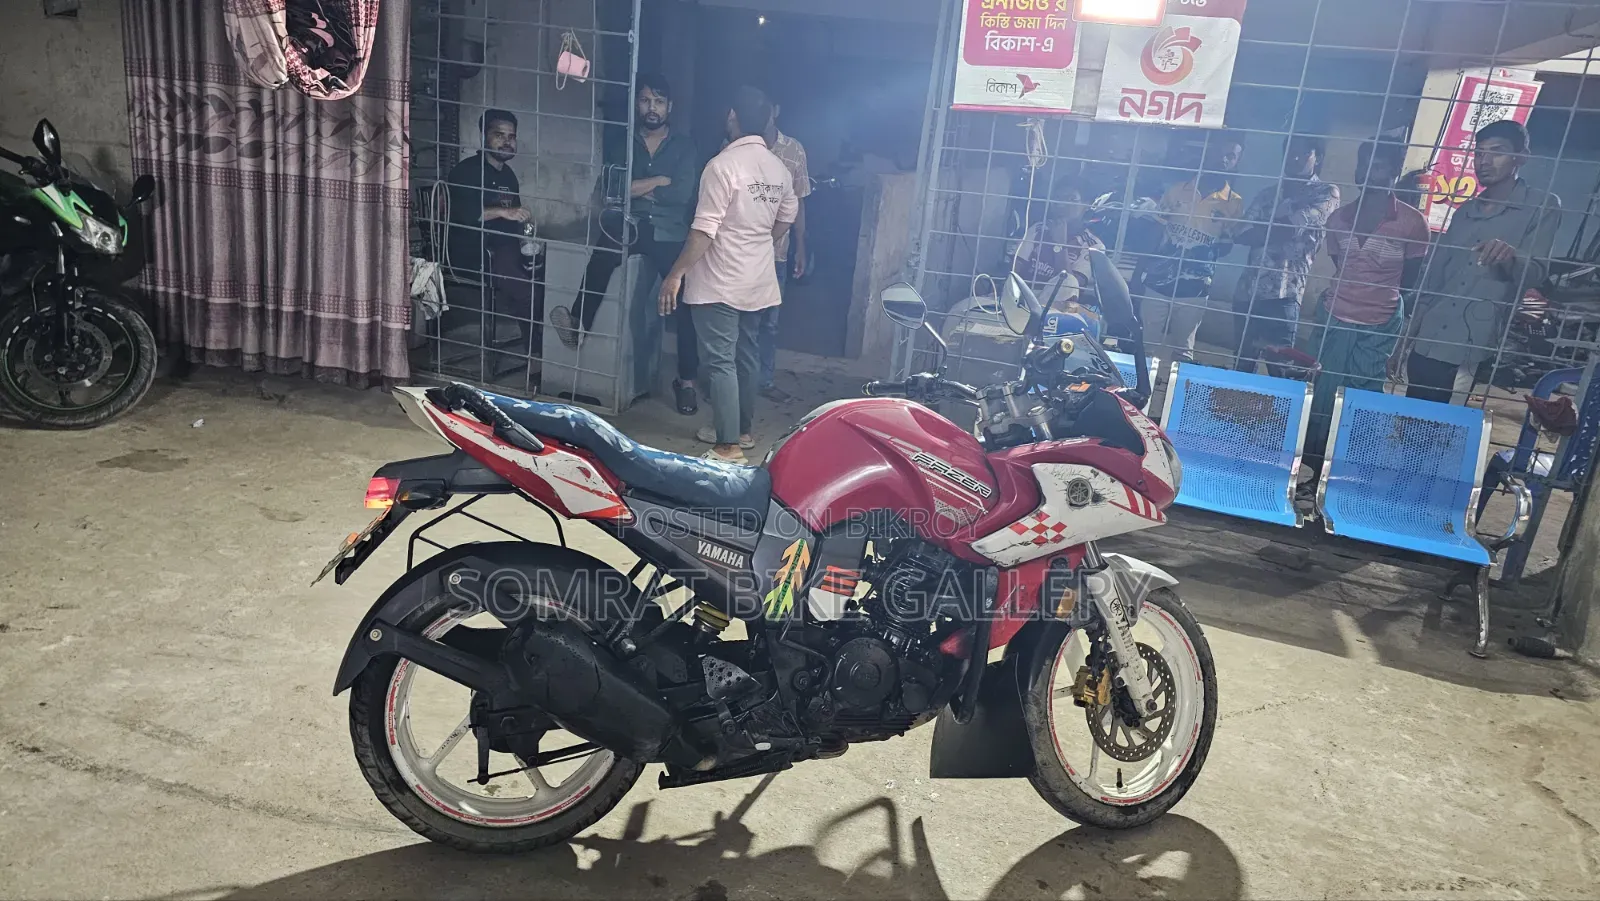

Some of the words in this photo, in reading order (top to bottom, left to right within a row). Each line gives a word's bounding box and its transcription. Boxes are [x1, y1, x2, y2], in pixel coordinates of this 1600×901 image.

[980, 12, 1011, 29] কিস্তি
[1014, 17, 1041, 29] জমা
[1045, 14, 1067, 30] দিন
[984, 30, 1054, 52] বিকাশ-এ
[985, 77, 1017, 94] বিকাশ
[1118, 87, 1206, 123] নগদ
[912, 452, 992, 498] FAZER
[697, 540, 744, 569] YAMAHA
